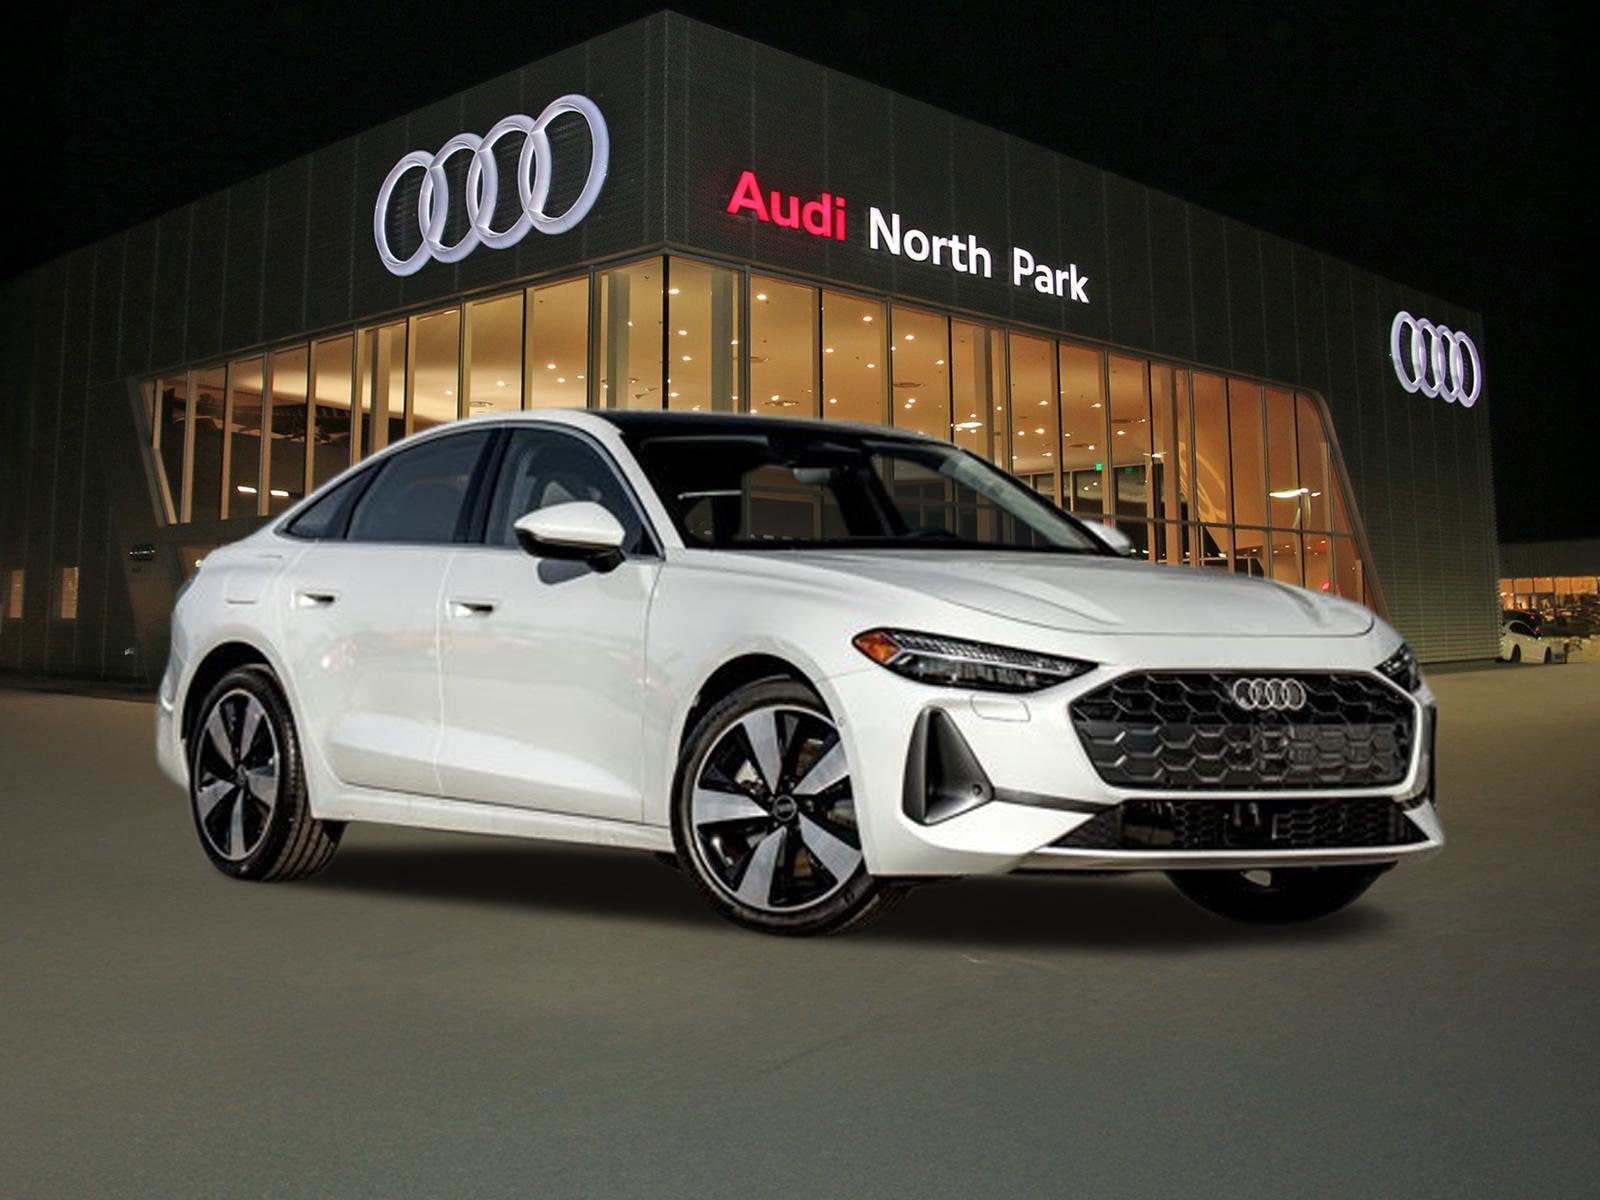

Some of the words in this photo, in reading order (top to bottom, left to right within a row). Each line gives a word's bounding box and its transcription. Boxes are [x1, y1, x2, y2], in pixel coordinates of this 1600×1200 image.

[726, 170, 847, 241] Audi
[868, 206, 992, 278] North
[1012, 246, 1090, 304] Park
